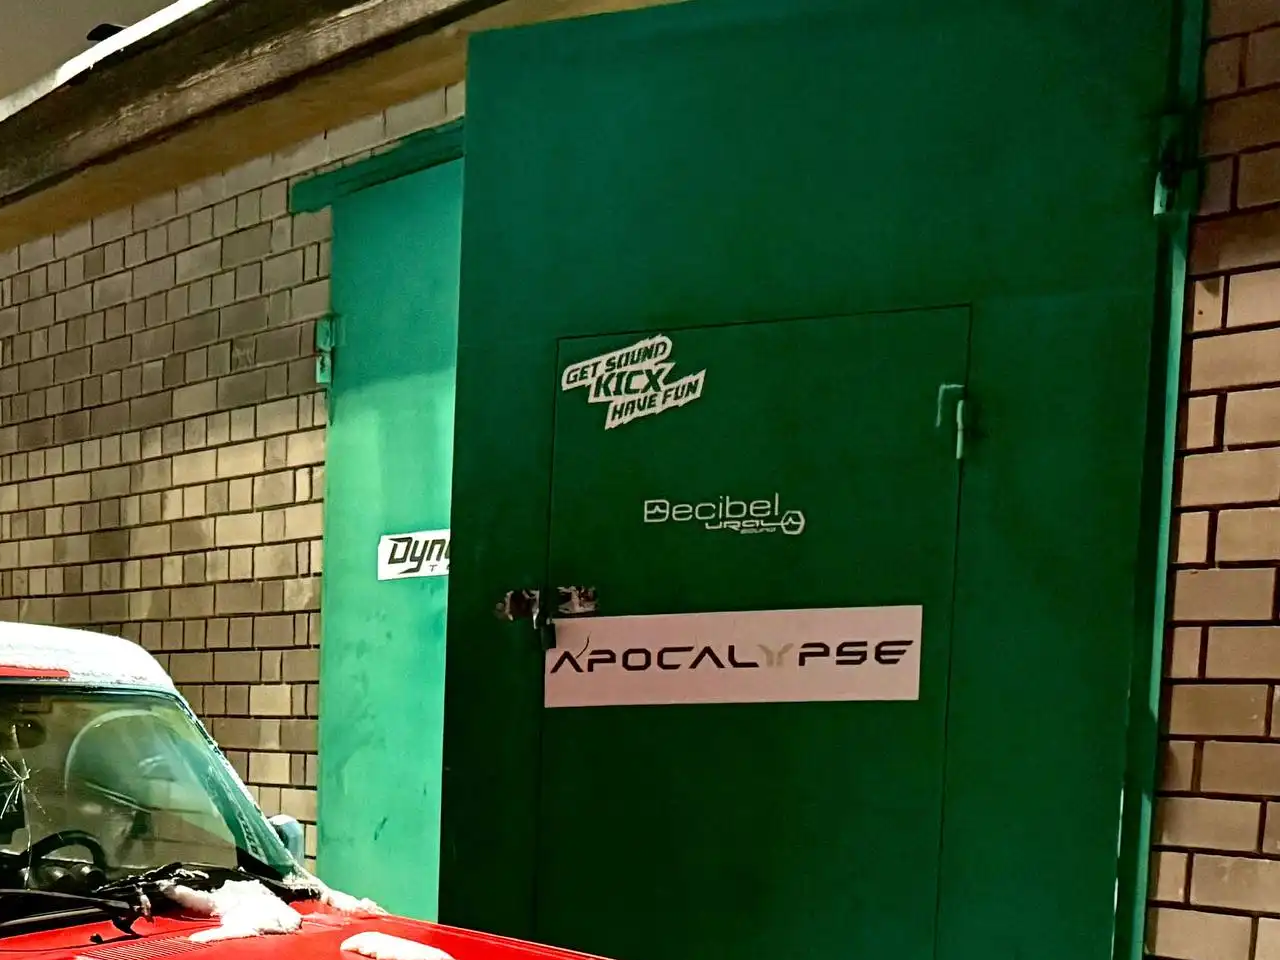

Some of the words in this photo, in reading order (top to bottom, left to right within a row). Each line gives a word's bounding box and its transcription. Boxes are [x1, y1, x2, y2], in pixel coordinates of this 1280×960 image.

[566, 360, 602, 385] GET
[604, 341, 668, 373] SOUND
[593, 367, 667, 398] KICX
[610, 393, 658, 421] HAVE
[661, 378, 700, 405] FUN
[643, 492, 780, 523] Decibel
[549, 638, 914, 674] APOCALYPSE
